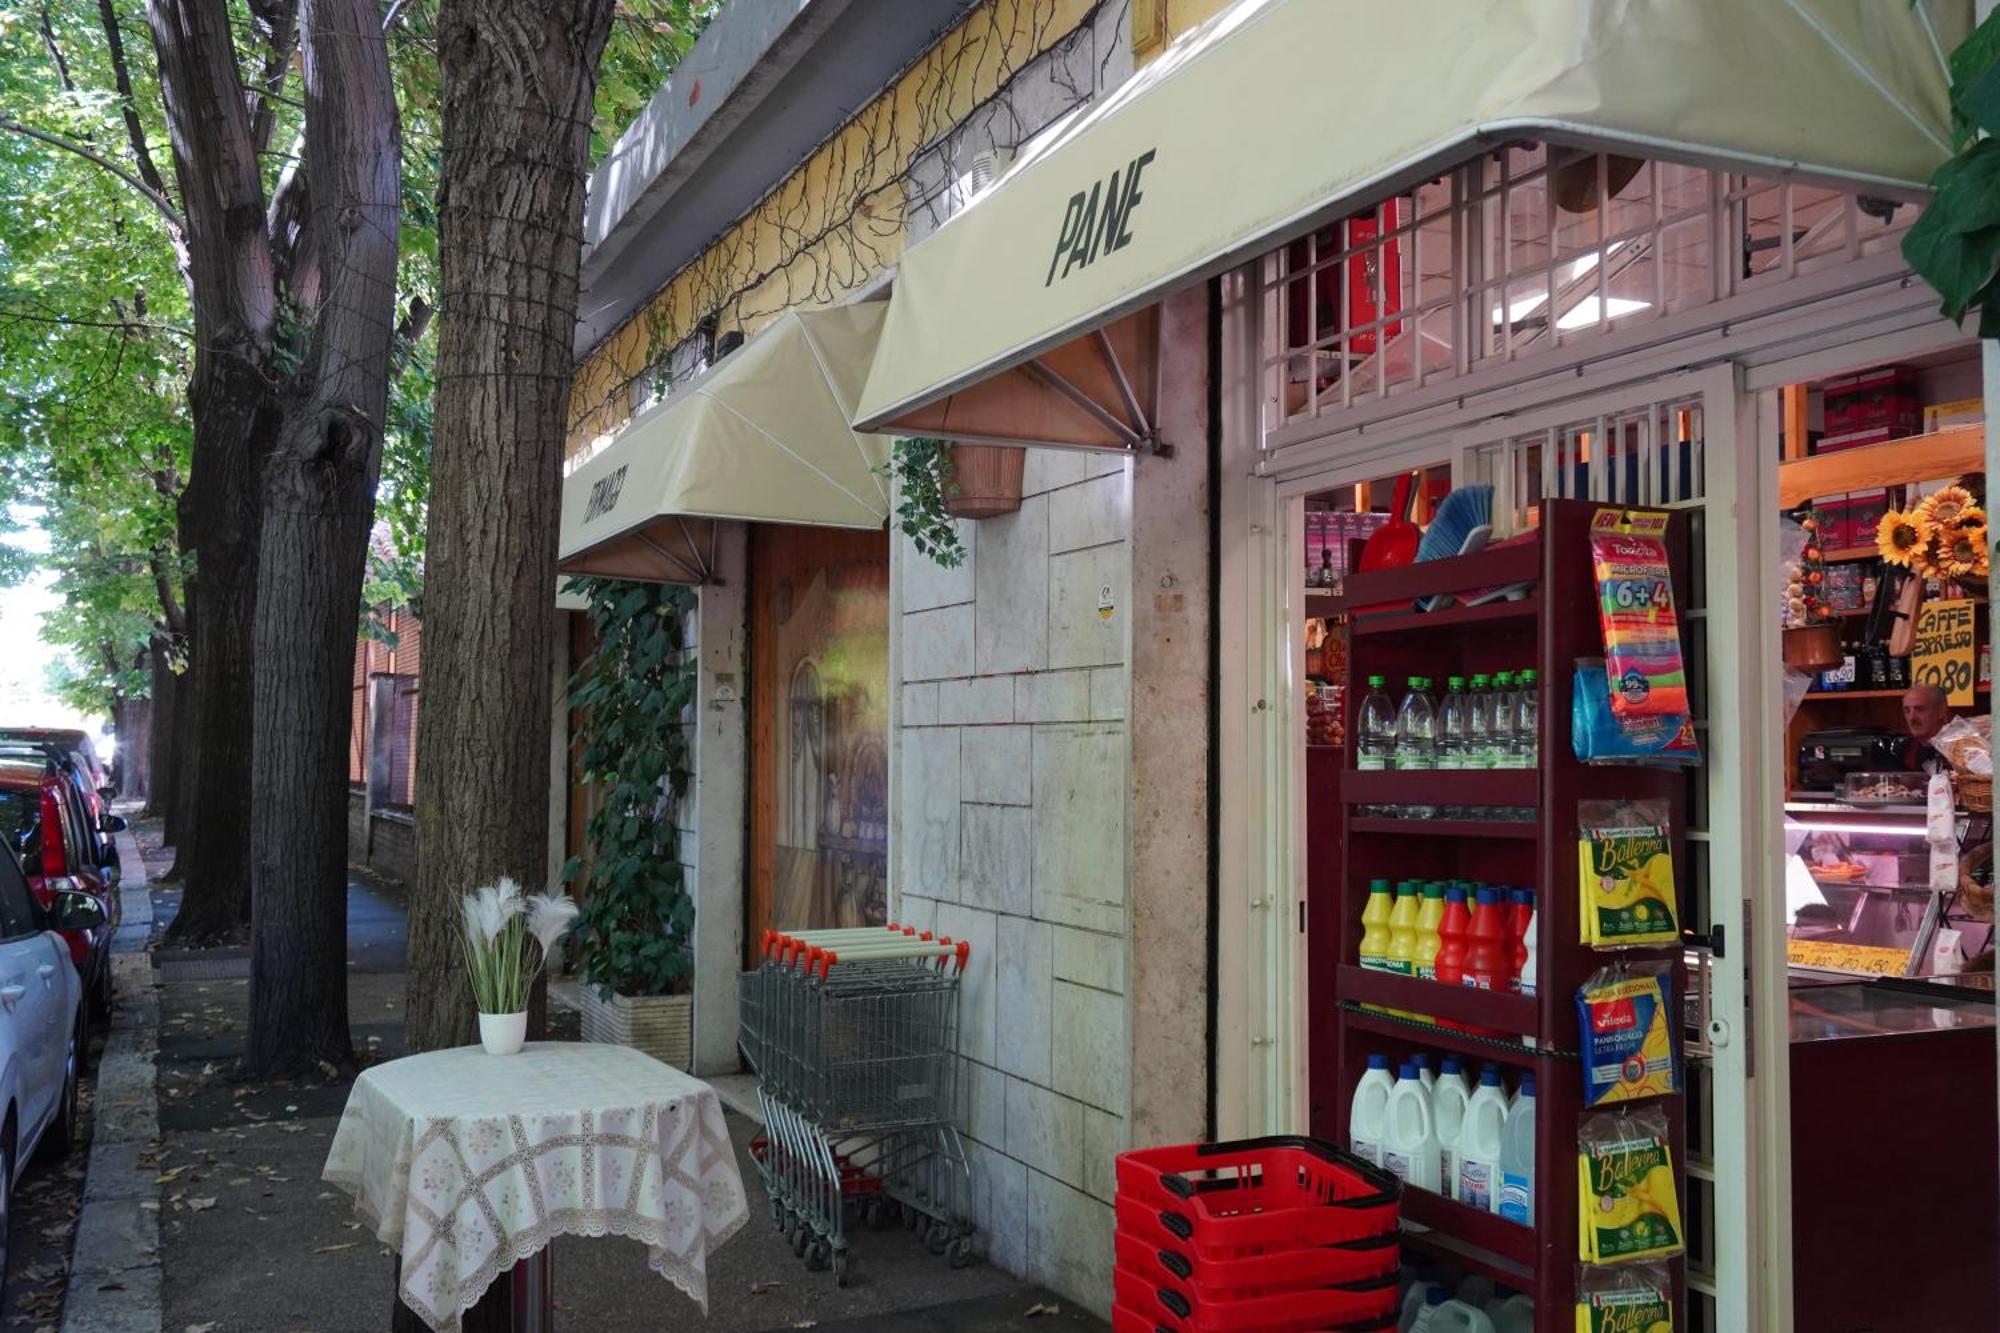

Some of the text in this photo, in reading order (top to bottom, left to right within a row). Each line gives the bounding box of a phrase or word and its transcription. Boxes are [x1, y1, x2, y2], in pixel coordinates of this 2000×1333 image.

[1045, 147, 1157, 288] PANE
[1599, 836, 1663, 872] Ballerina
[1599, 1150, 1660, 1191] Ballerina
[1600, 1300, 1664, 1333] Ballerina
